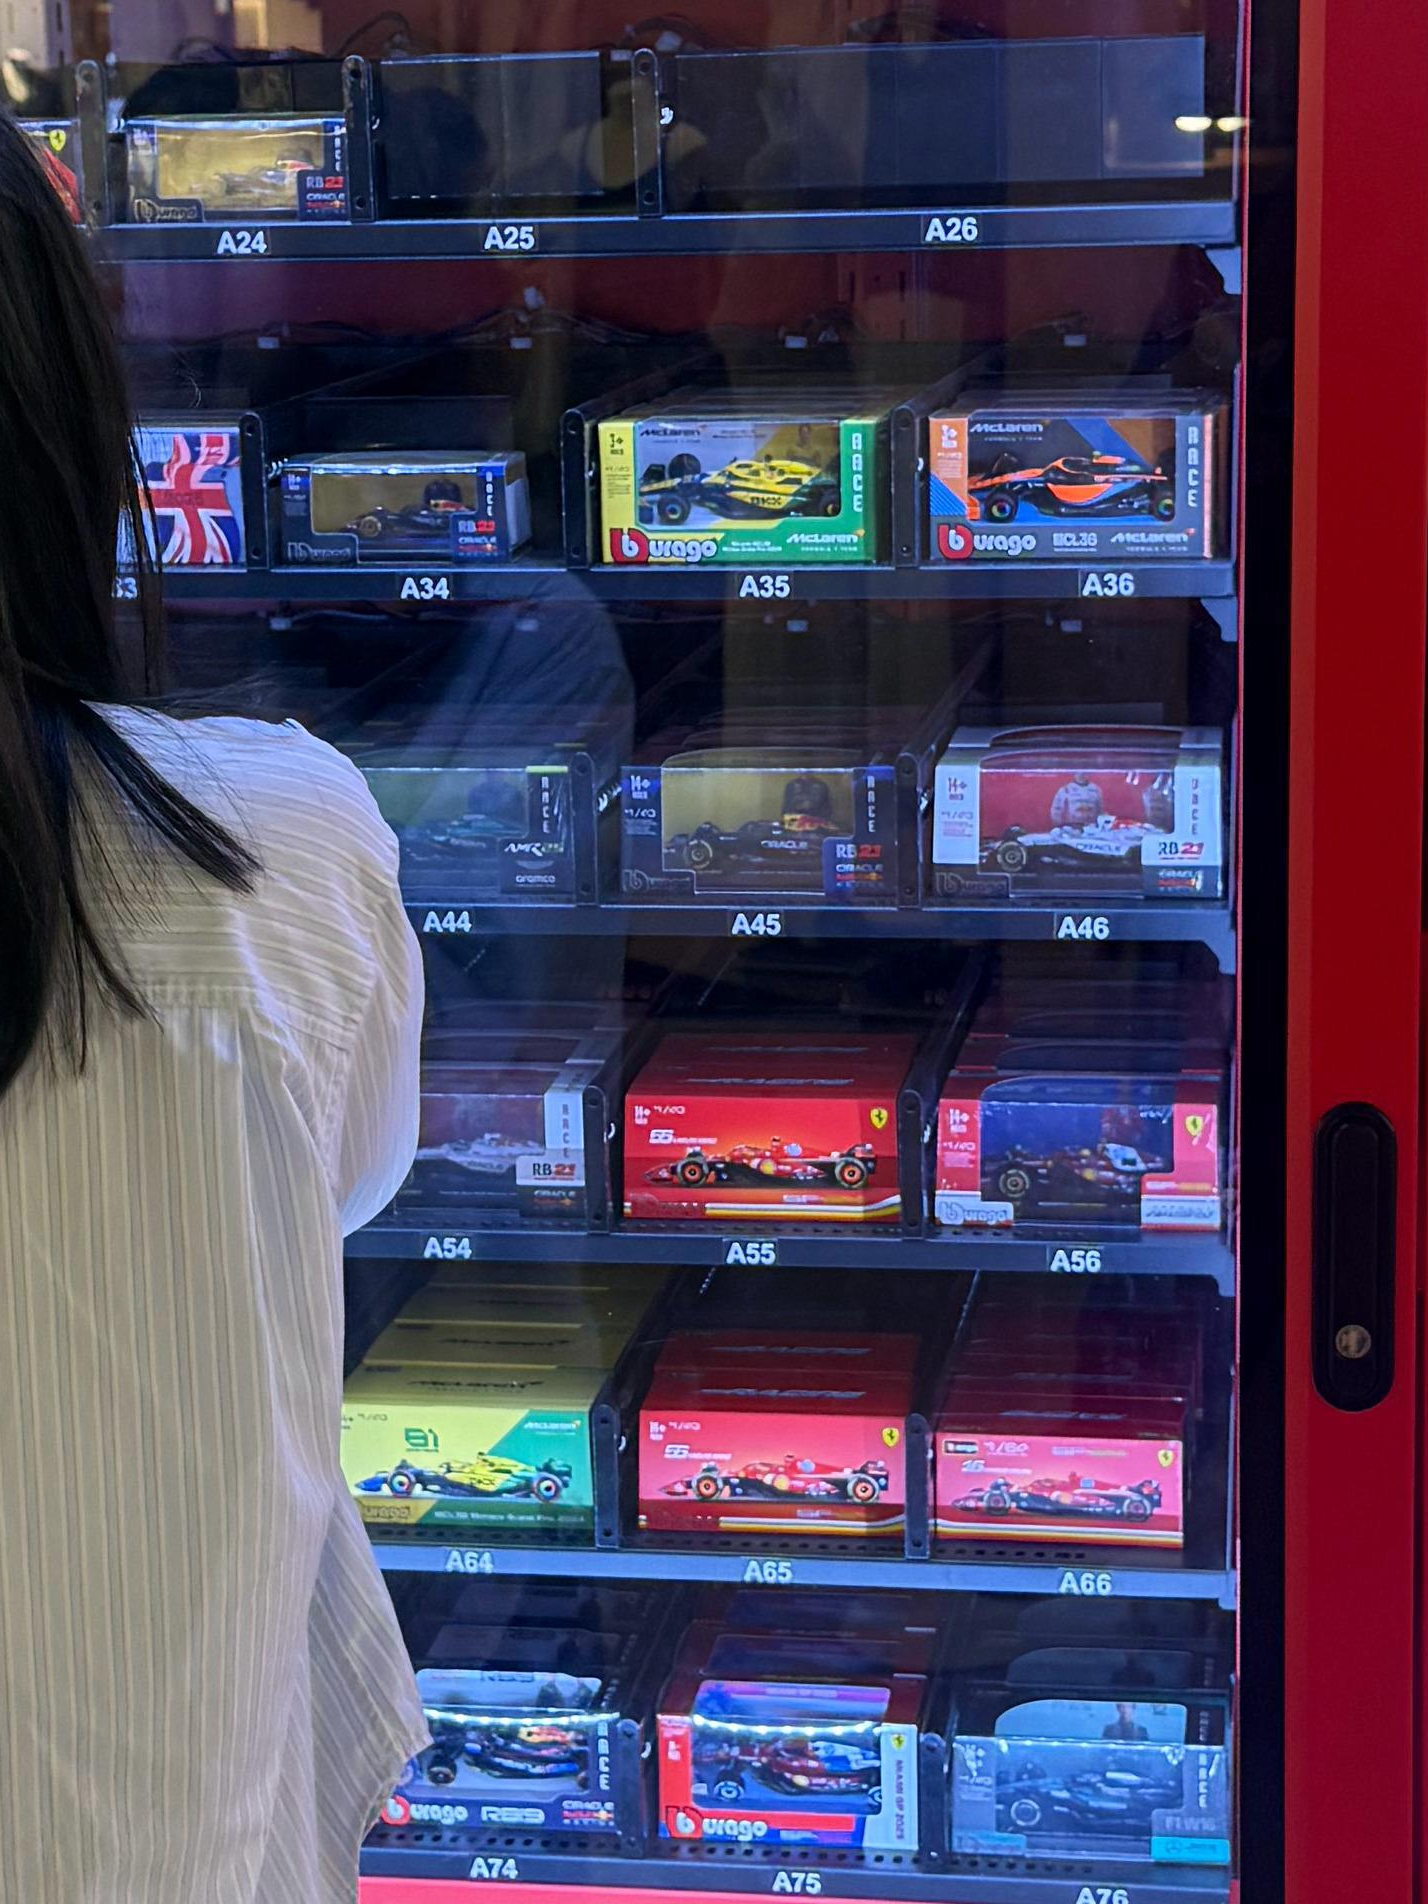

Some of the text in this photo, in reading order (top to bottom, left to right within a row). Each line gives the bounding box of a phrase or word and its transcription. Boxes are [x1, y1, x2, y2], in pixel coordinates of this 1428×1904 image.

[483, 226, 535, 250] A25
[925, 216, 978, 241] A26
[217, 229, 267, 254] A24
[969, 423, 1044, 433] McLaren
[852, 433, 863, 512] RACE
[1188, 426, 1199, 508] RACE
[610, 528, 717, 563] burago
[786, 533, 858, 544] McLaren
[938, 524, 1037, 559] burago
[1111, 532, 1188, 544] McLaren
[400, 577, 449, 599] A34
[739, 575, 790, 598] A35
[1082, 573, 1134, 596] A36
[423, 910, 472, 933] A44
[731, 912, 782, 937] A45
[1058, 917, 1110, 939] A46
[424, 1237, 472, 1259] A54
[726, 1242, 776, 1265] A55
[1050, 1250, 1101, 1272] A56
[445, 1551, 493, 1573] A64
[743, 1560, 792, 1583] A65
[1059, 1572, 1112, 1595] A66
[666, 1806, 768, 1841] burago
[470, 1857, 518, 1879] A74
[773, 1872, 821, 1893] A75
